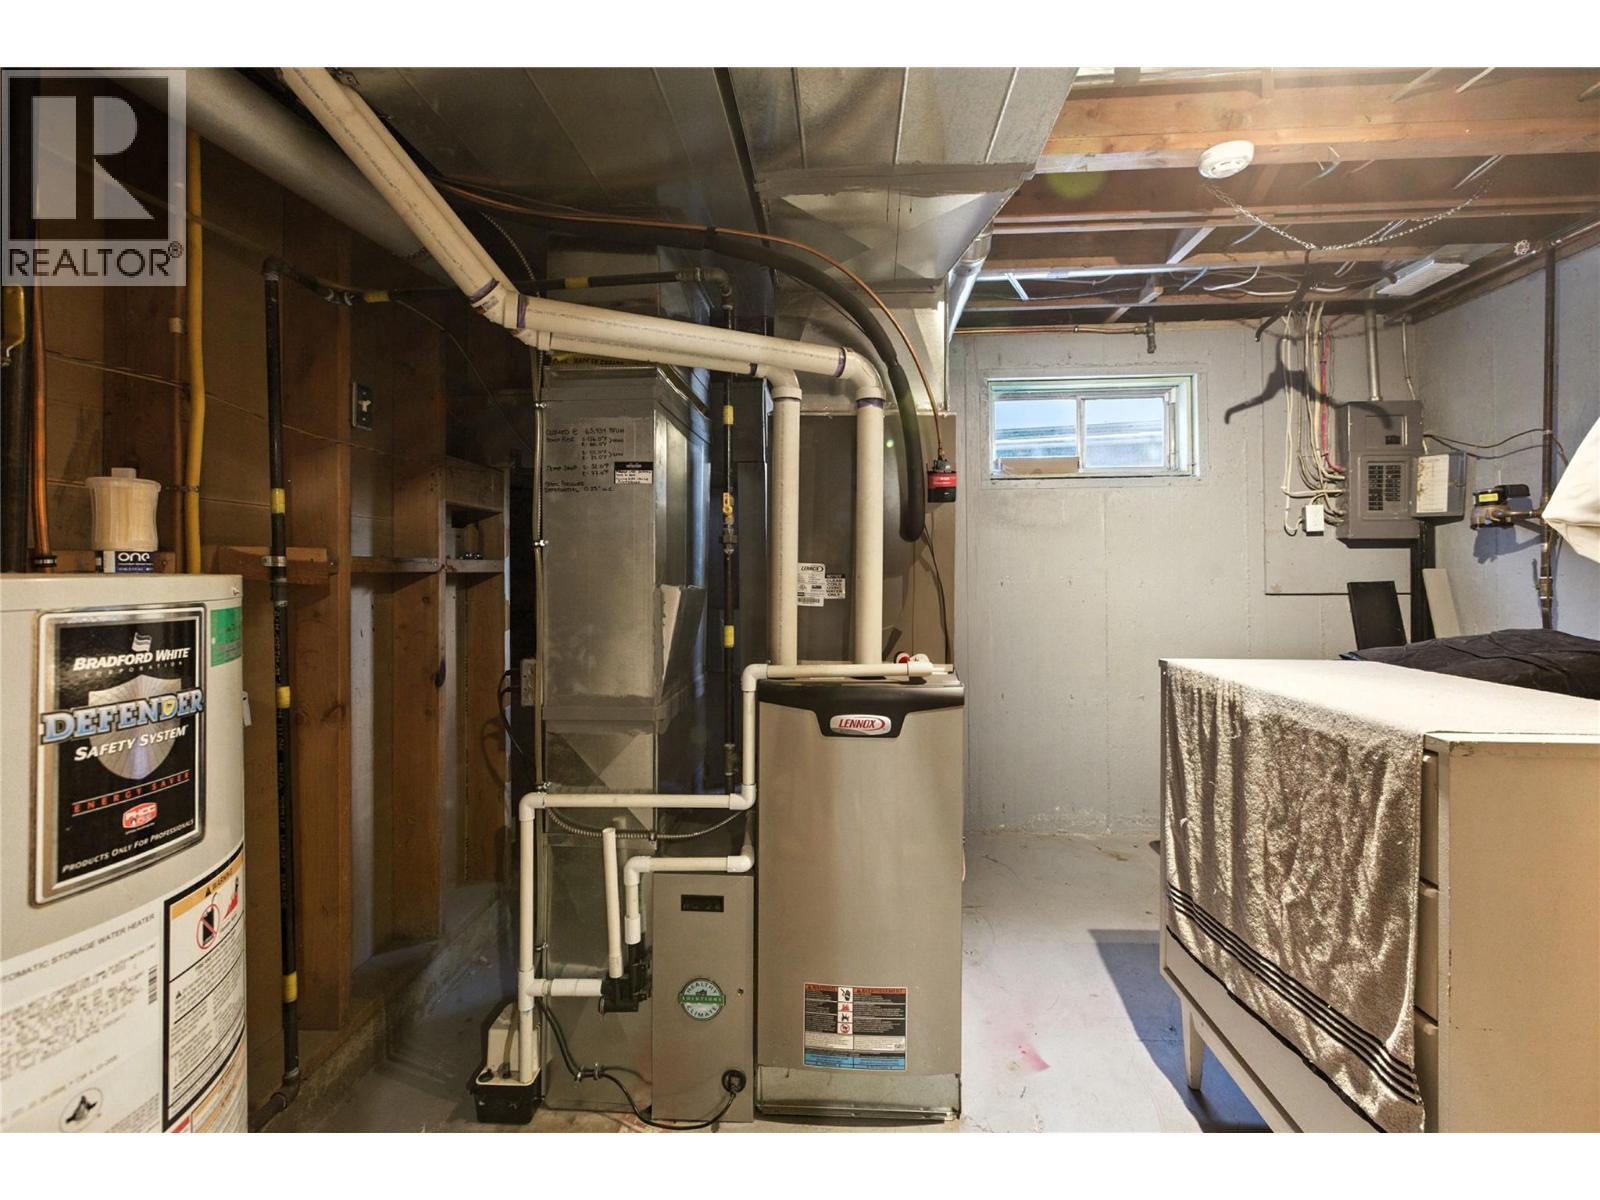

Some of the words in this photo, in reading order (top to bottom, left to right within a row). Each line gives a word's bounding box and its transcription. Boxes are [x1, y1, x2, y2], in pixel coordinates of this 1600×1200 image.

[117, 552, 150, 562] one
[73, 652, 153, 671] BRADFORD
[155, 647, 192, 662] WHITE
[42, 689, 204, 744] DEFENDER
[838, 719, 876, 729] LENNOX
[74, 738, 136, 761] SAFETY
[73, 789, 143, 813] ENERGY
[151, 771, 191, 791] SAVER
[62, 852, 110, 874] PRODUCTS
[111, 844, 133, 857] ONLY
[133, 838, 150, 849] FOR
[150, 819, 194, 842] PROFESSIONALS
[51, 940, 96, 965] STORAGE
[97, 927, 127, 945] WATER
[127, 912, 156, 932] HEATER
[686, 982, 718, 994] HEALTHY
[686, 1005, 718, 1018] CLIMATE
